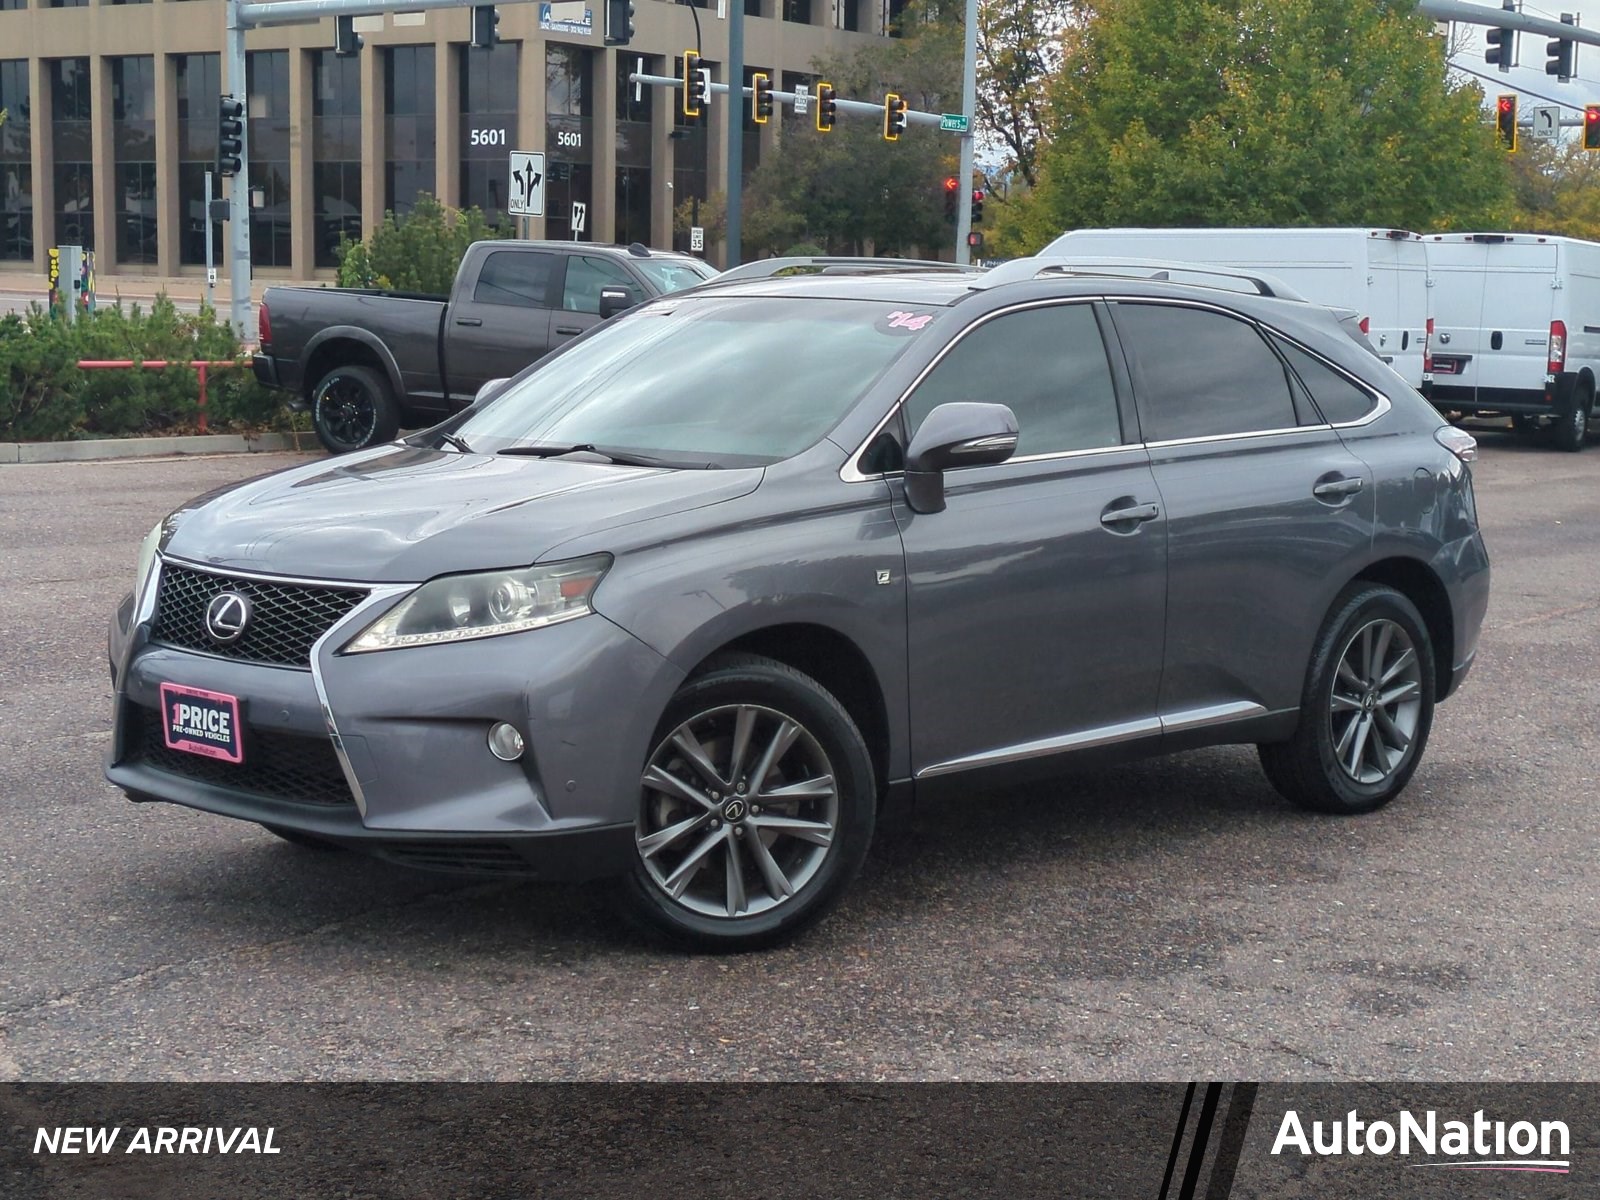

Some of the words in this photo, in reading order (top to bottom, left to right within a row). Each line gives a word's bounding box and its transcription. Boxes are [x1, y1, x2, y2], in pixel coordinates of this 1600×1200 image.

[470, 129, 506, 145] 5601
[557, 132, 582, 147] 5601
[510, 199, 525, 209] ONLY
[692, 239, 703, 249] 35
[172, 724, 204, 738] PRE-OWNED
[204, 730, 230, 743] VEHICLES
